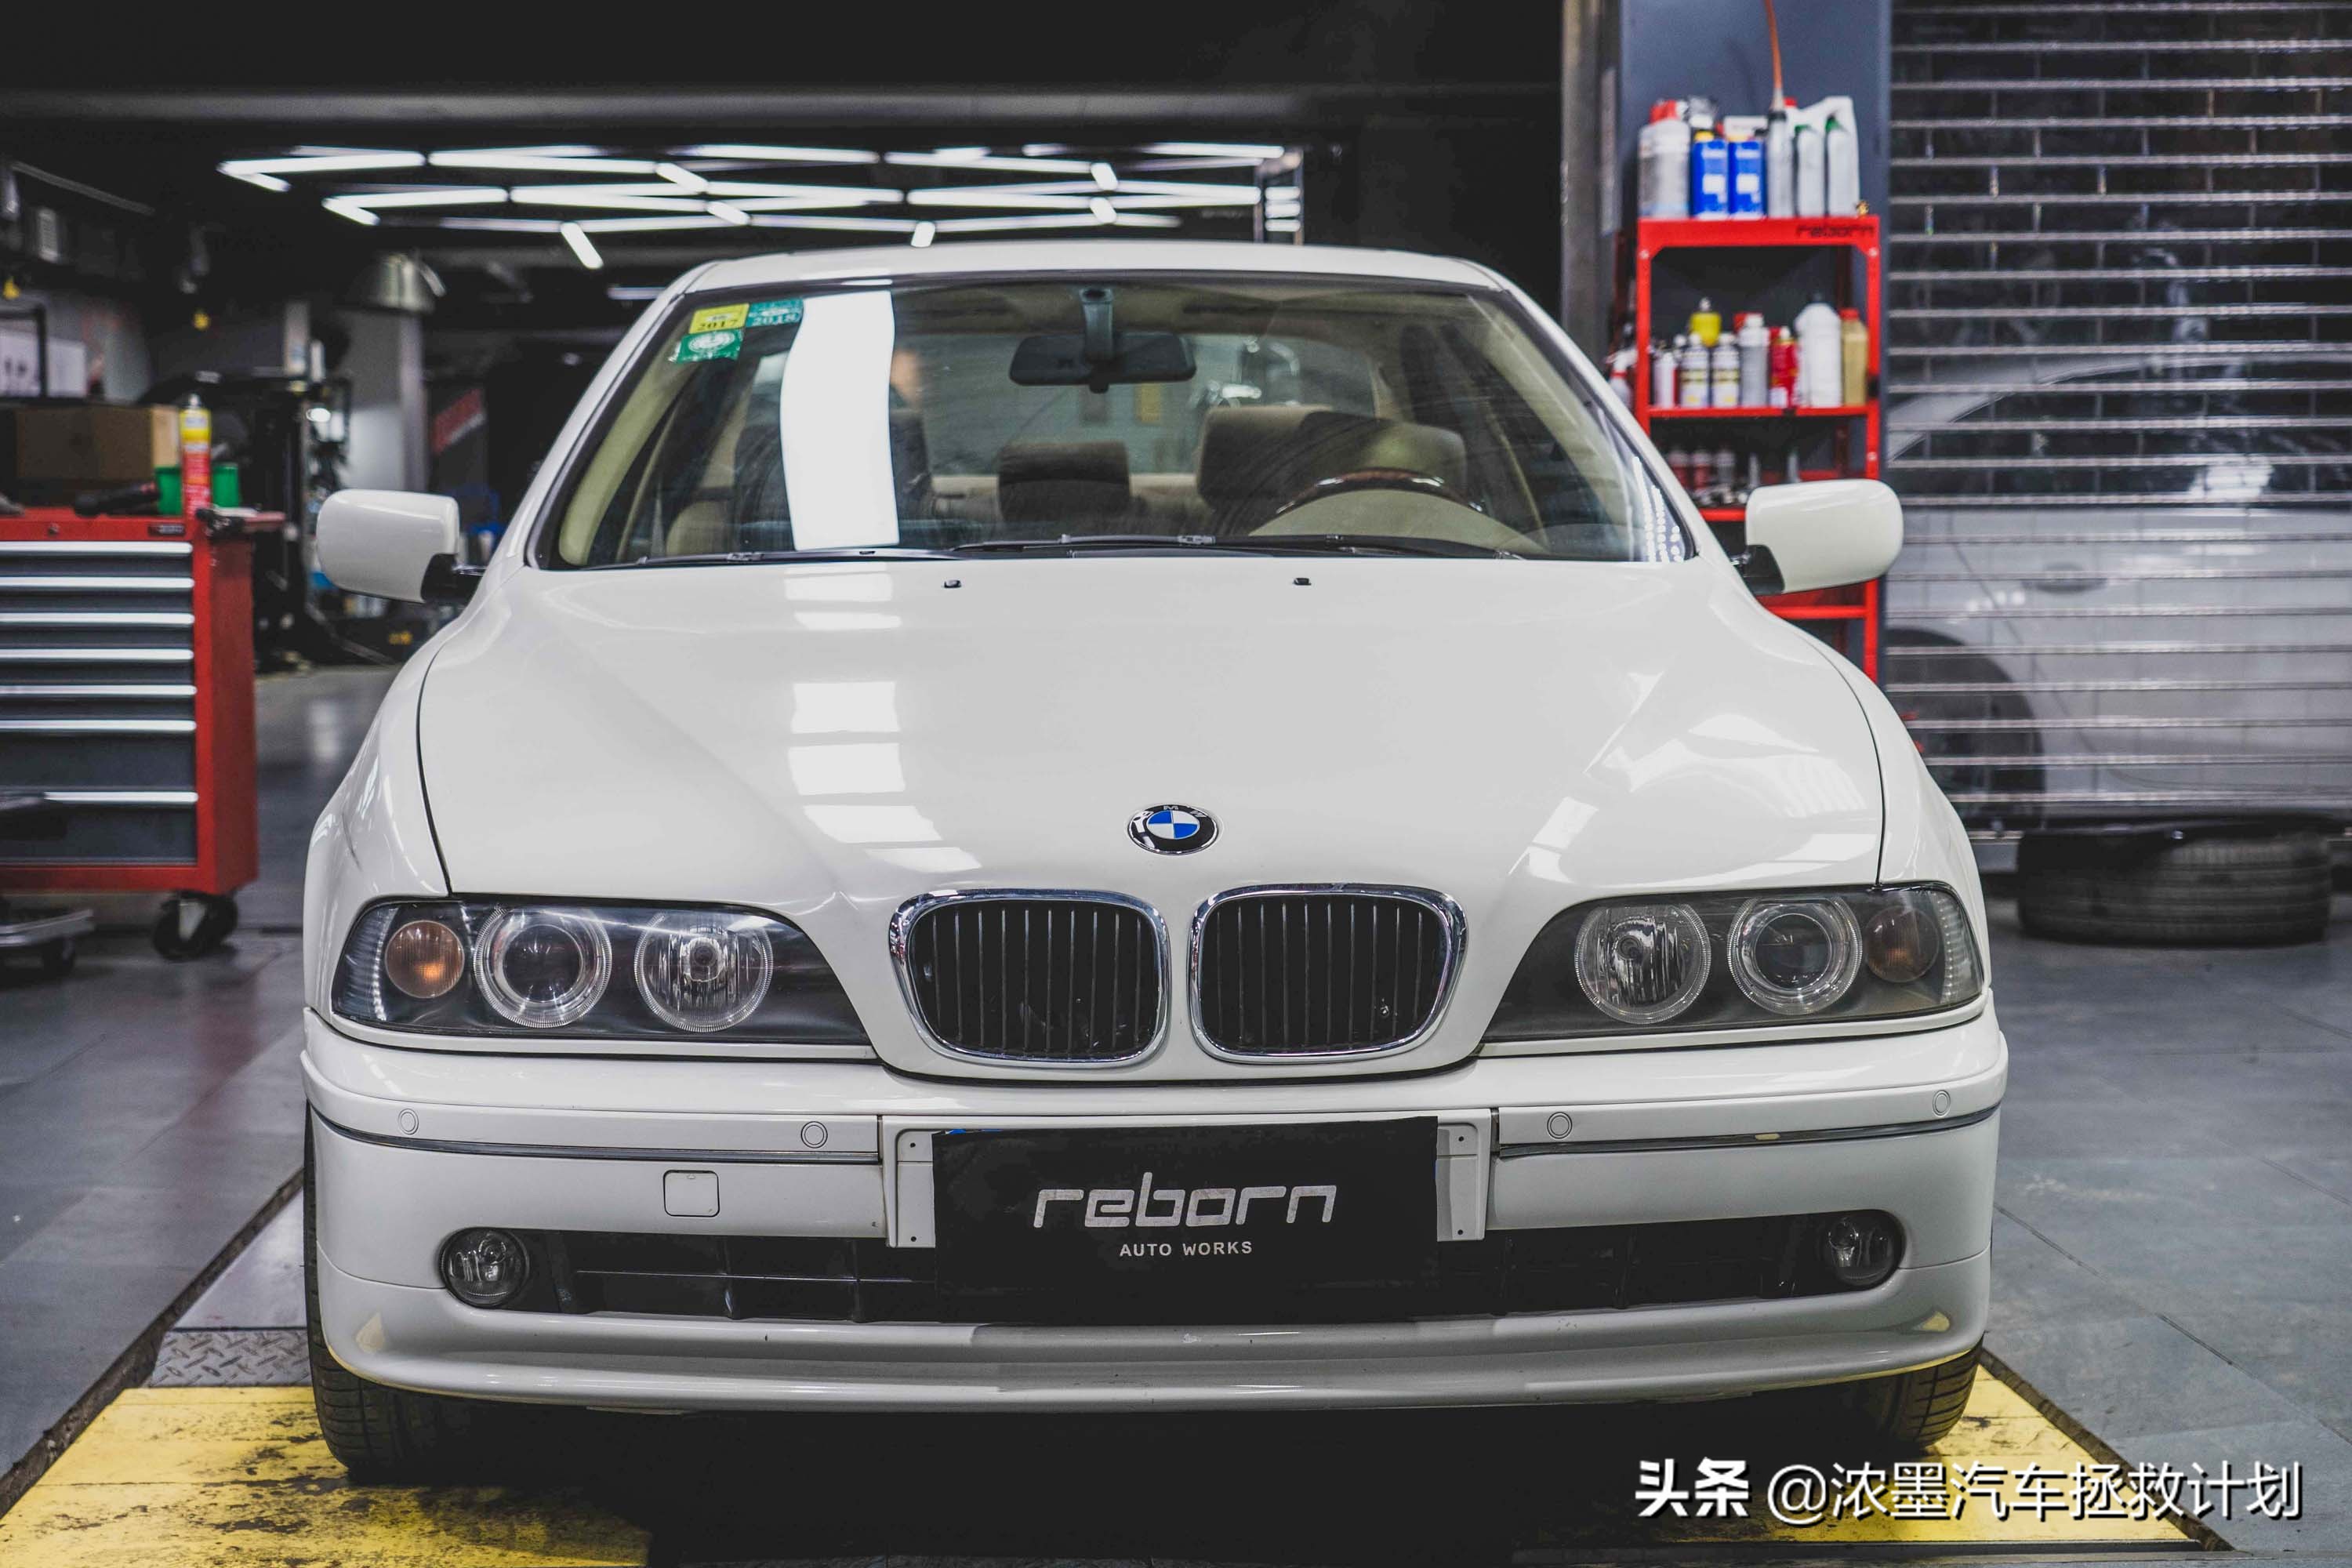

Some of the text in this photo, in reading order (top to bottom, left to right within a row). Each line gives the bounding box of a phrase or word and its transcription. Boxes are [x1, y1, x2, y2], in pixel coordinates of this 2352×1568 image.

[697, 319, 739, 331] 2017
[1033, 1171, 1337, 1229] reborn
[1119, 1240, 1253, 1258] AUTO WORKS
